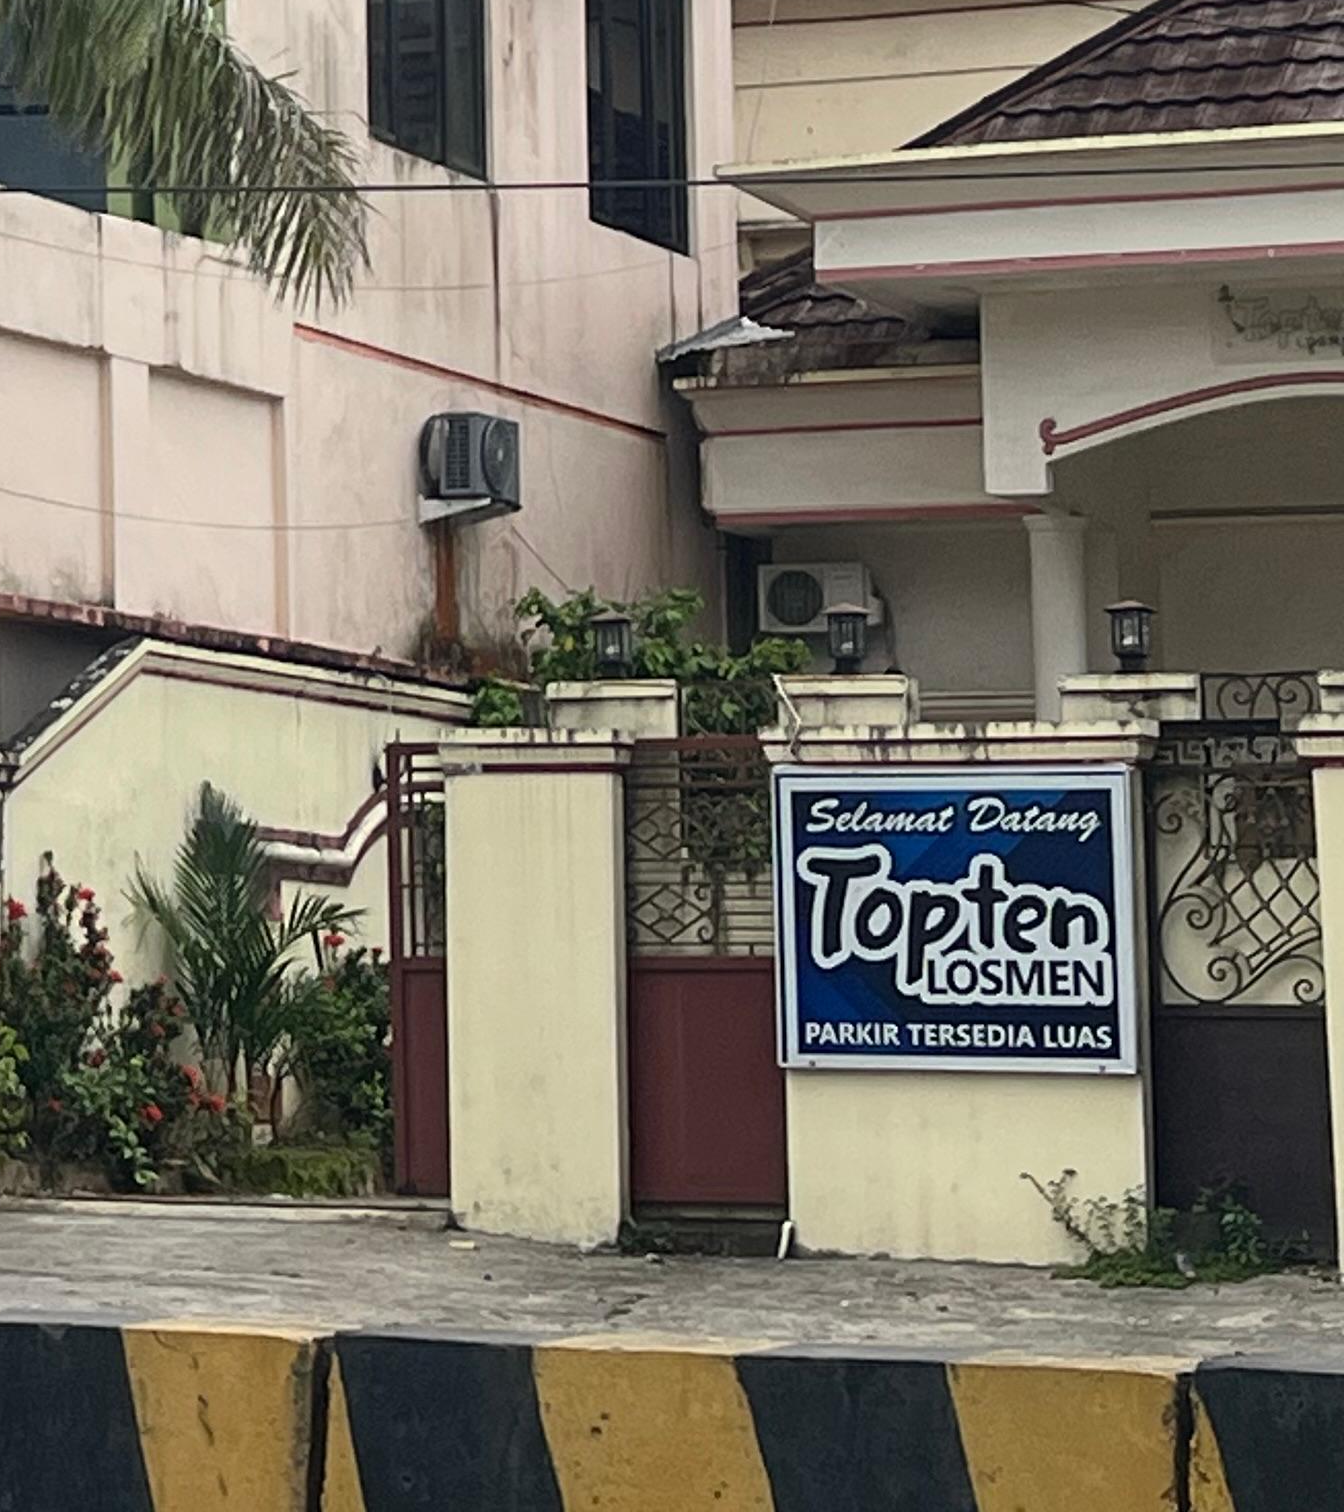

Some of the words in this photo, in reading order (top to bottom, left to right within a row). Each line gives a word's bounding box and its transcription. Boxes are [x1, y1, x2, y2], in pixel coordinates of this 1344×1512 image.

[805, 796, 955, 834] Selamat
[965, 796, 1103, 842] Datang
[926, 959, 1105, 997] LOSMEN
[804, 1022, 900, 1046] PARKIR
[906, 1023, 1036, 1048] TERSEDIA
[1042, 1024, 1113, 1049] LUAS
